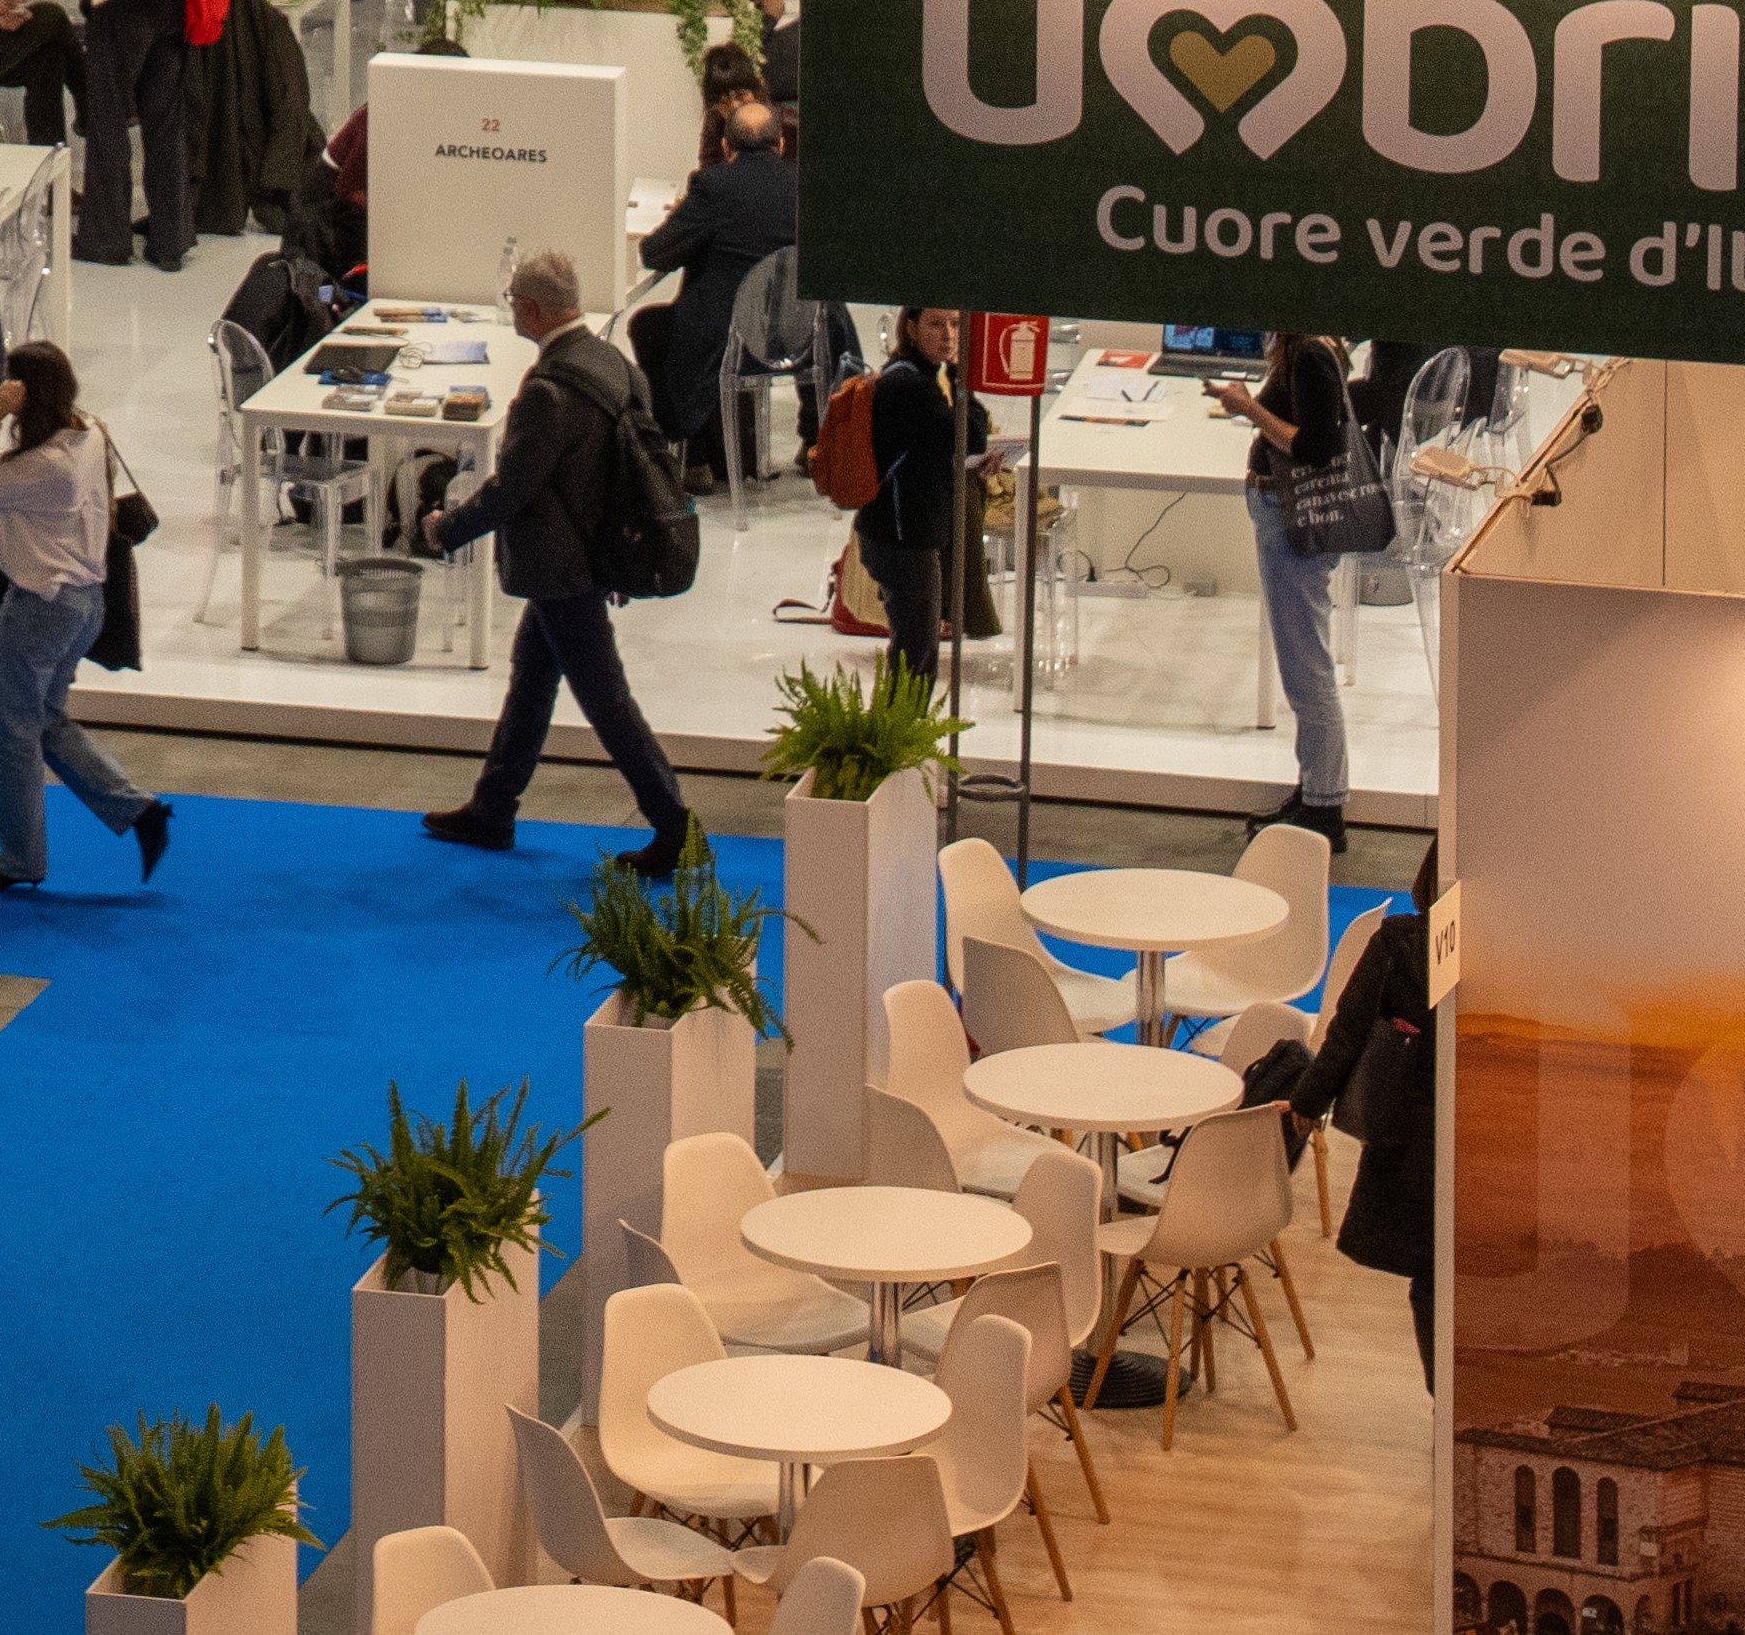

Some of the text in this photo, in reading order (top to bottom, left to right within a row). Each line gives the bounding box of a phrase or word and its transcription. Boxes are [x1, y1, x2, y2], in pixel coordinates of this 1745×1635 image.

[481, 118, 501, 131] 22
[435, 143, 548, 164] ARCHEOARES
[1096, 185, 1340, 264] Cuore
[1366, 213, 1606, 283] verde
[1435, 919, 1457, 967] V10
